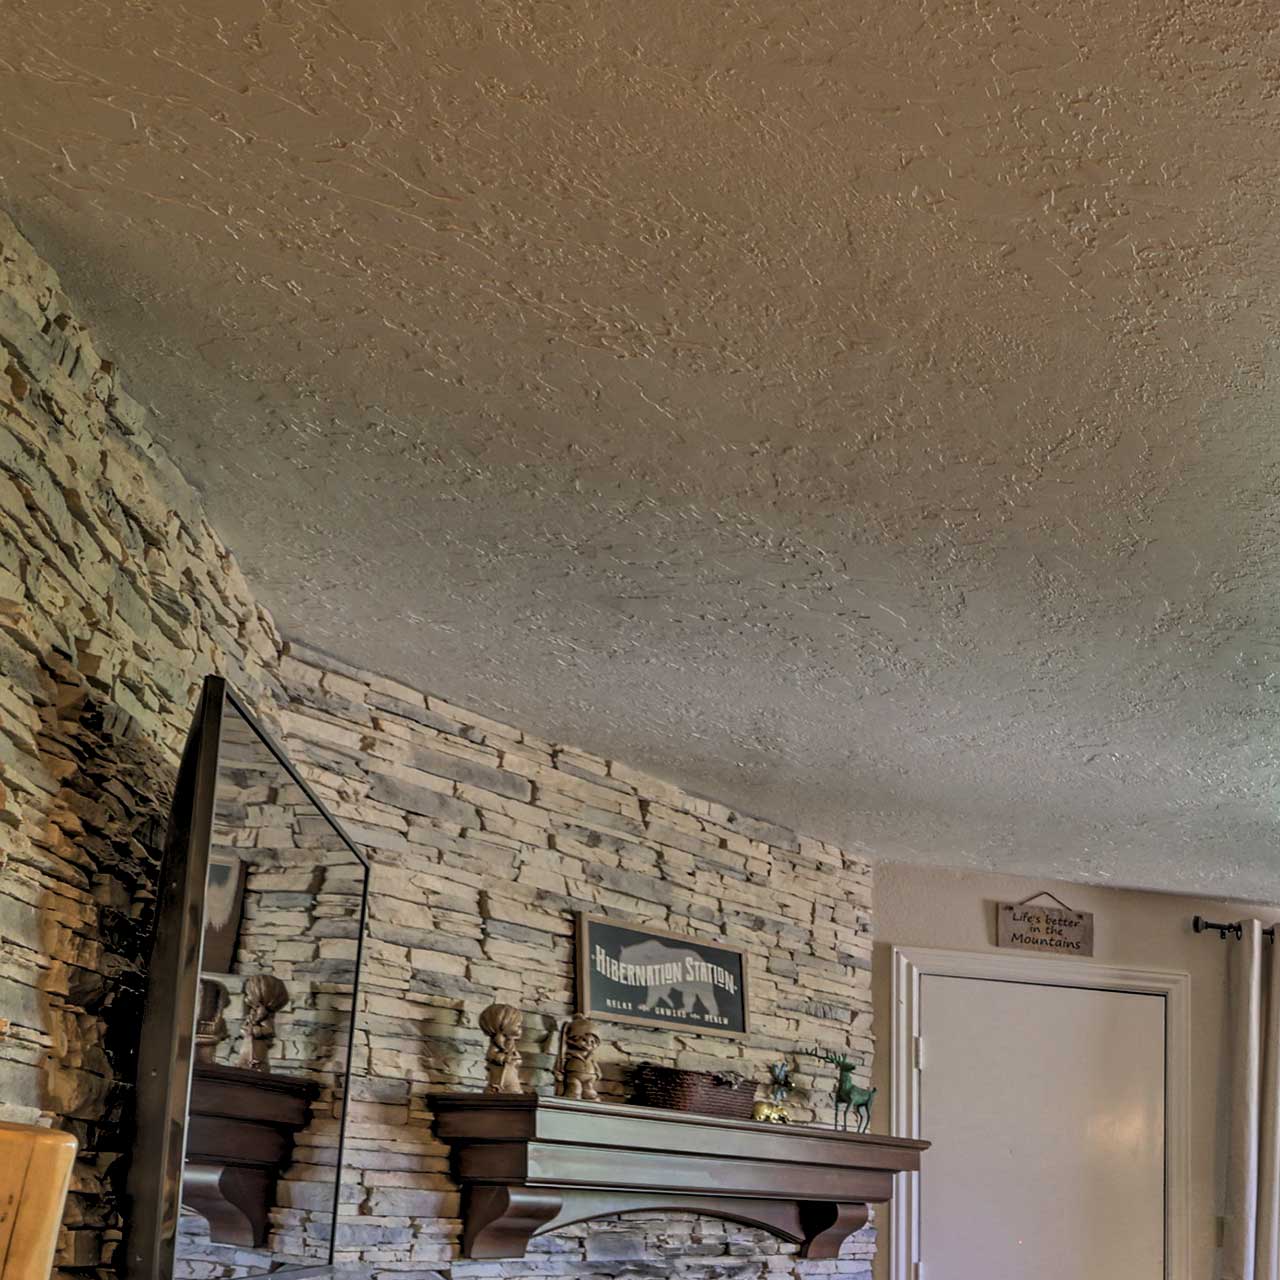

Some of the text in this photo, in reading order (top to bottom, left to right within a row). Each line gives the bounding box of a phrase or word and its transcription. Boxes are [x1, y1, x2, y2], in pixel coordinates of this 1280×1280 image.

[1012, 910, 1081, 928] Life's better
[1030, 922, 1063, 936] in the
[1011, 932, 1081, 950] Mountains
[606, 998, 632, 1010] RELAX
